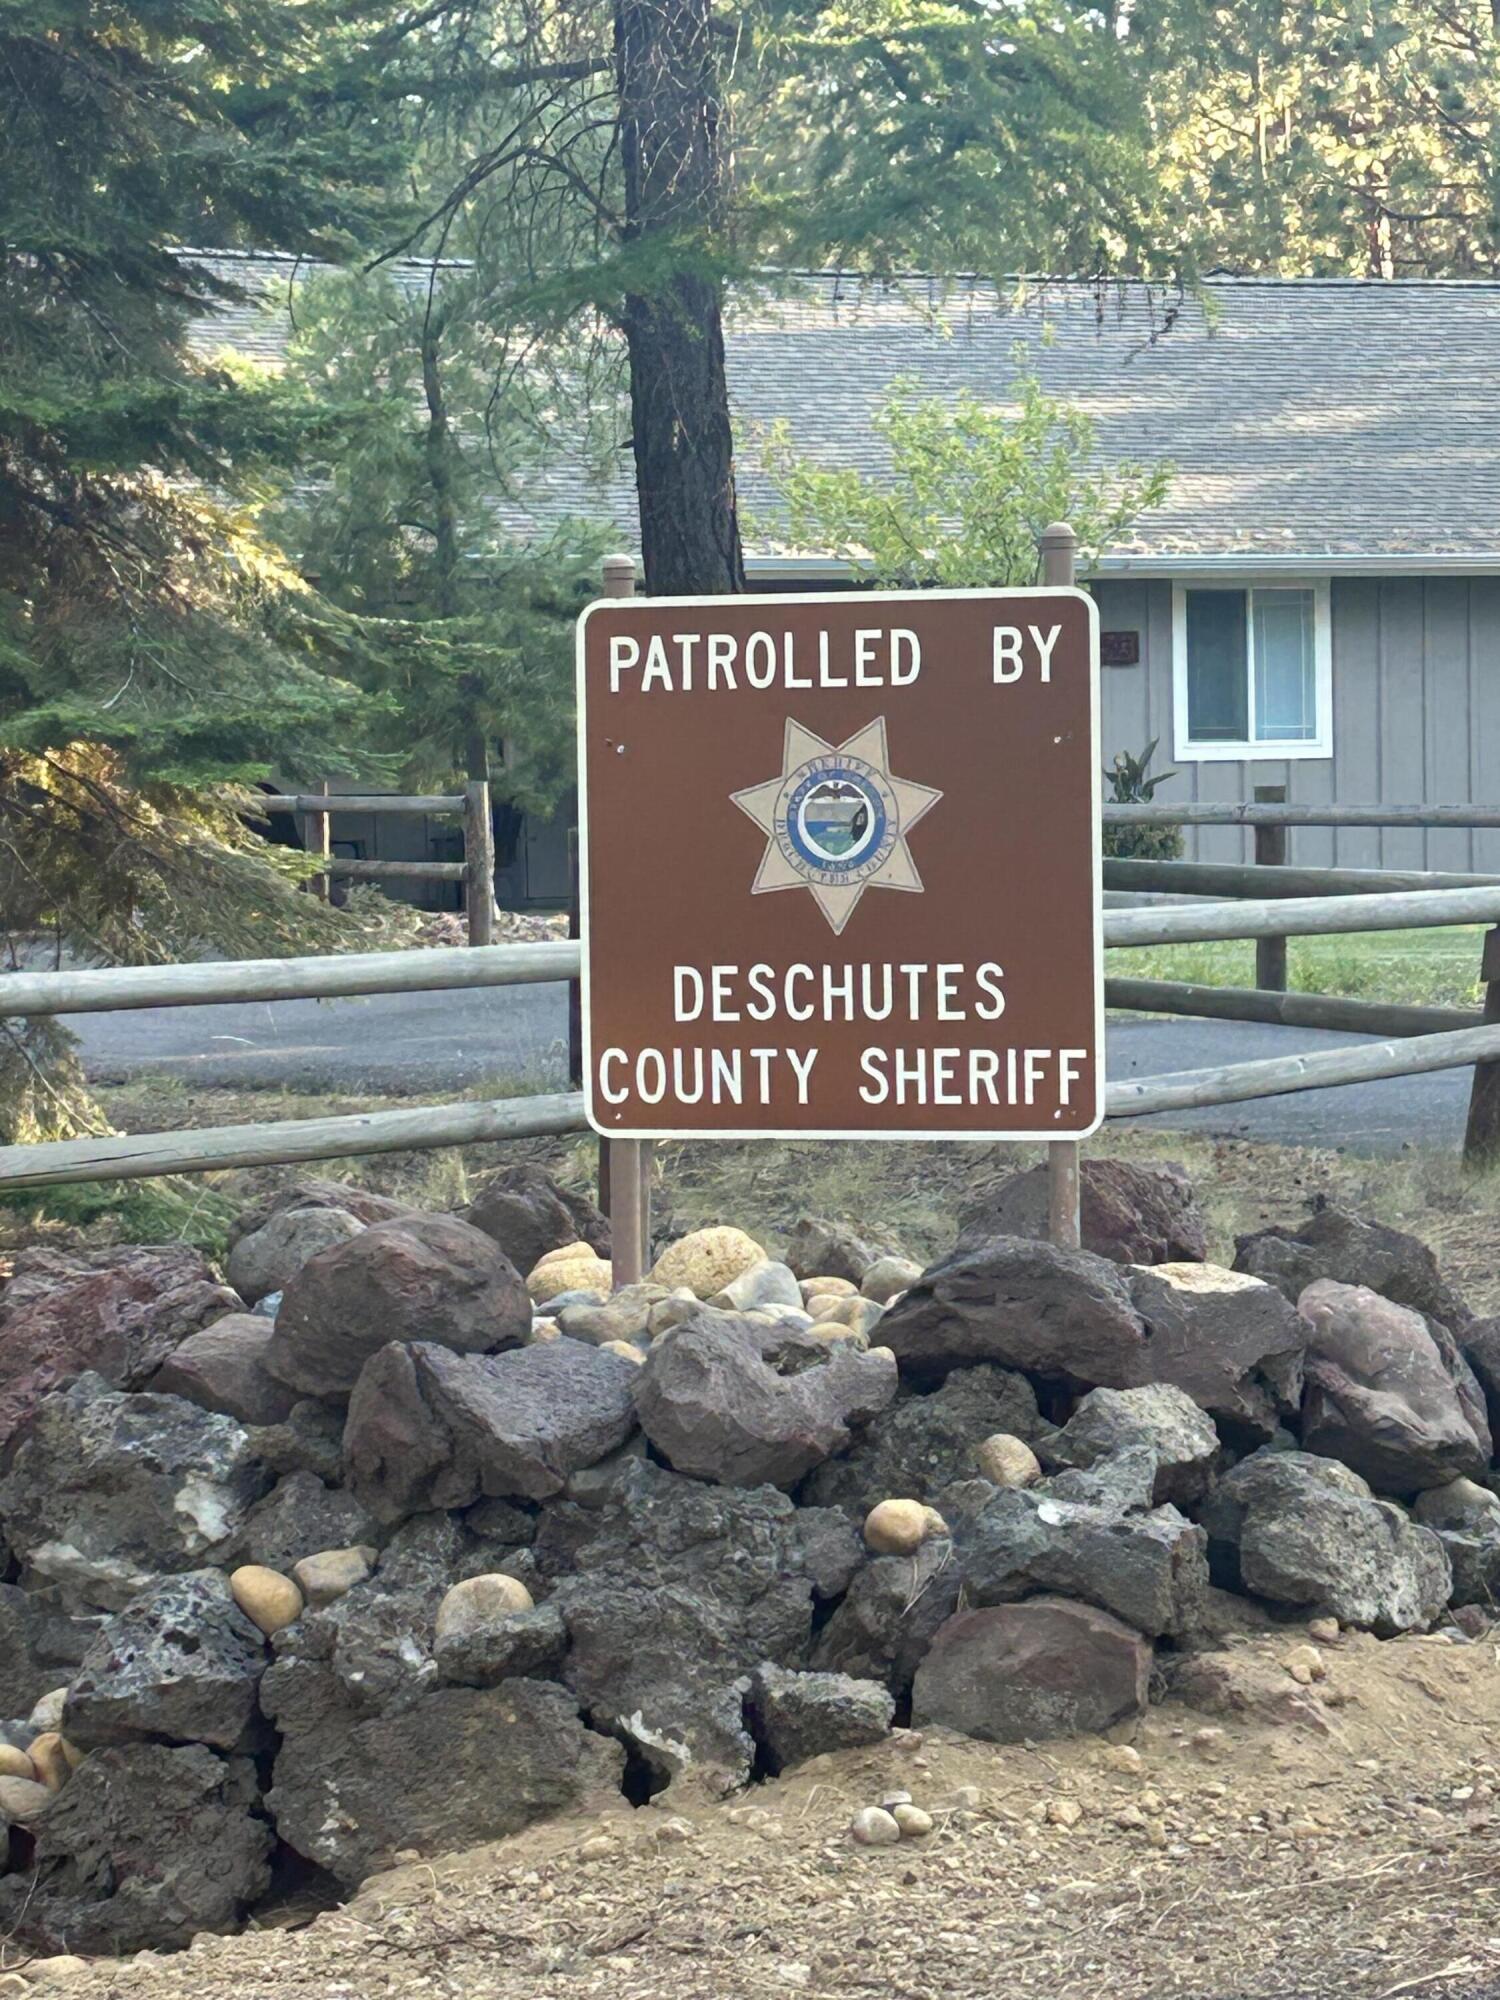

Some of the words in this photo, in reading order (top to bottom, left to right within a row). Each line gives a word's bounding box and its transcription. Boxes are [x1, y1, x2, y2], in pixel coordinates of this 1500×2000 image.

[609, 628, 922, 693] PATROLLED
[992, 624, 1063, 684] BY
[673, 961, 1006, 1022] DESCHUTES
[598, 1047, 819, 1106] COUNTY
[858, 1046, 1088, 1106] SHERIFF
